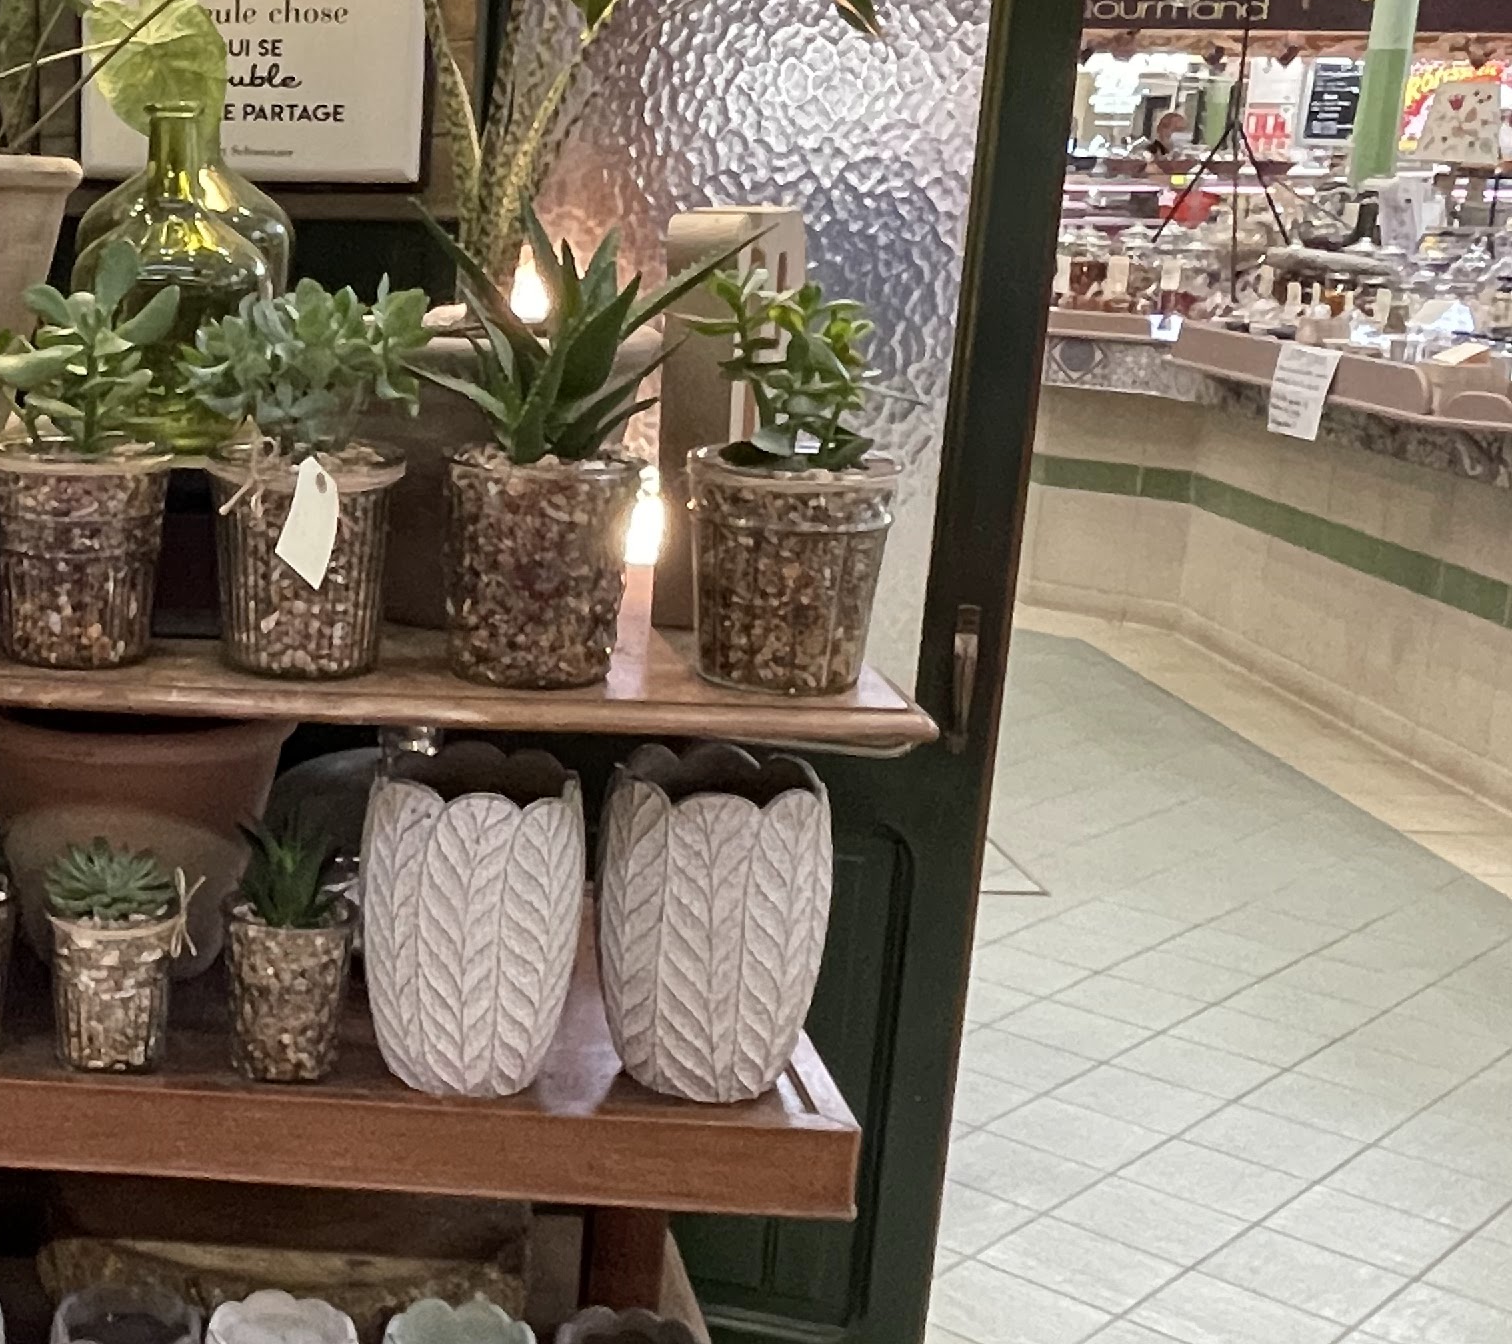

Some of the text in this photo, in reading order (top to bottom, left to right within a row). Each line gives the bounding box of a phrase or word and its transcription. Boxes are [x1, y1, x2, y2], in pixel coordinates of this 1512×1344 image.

[228, 38, 284, 58] UI SE
[226, 62, 303, 90] uble
[222, 103, 346, 123] E PARTAGE
